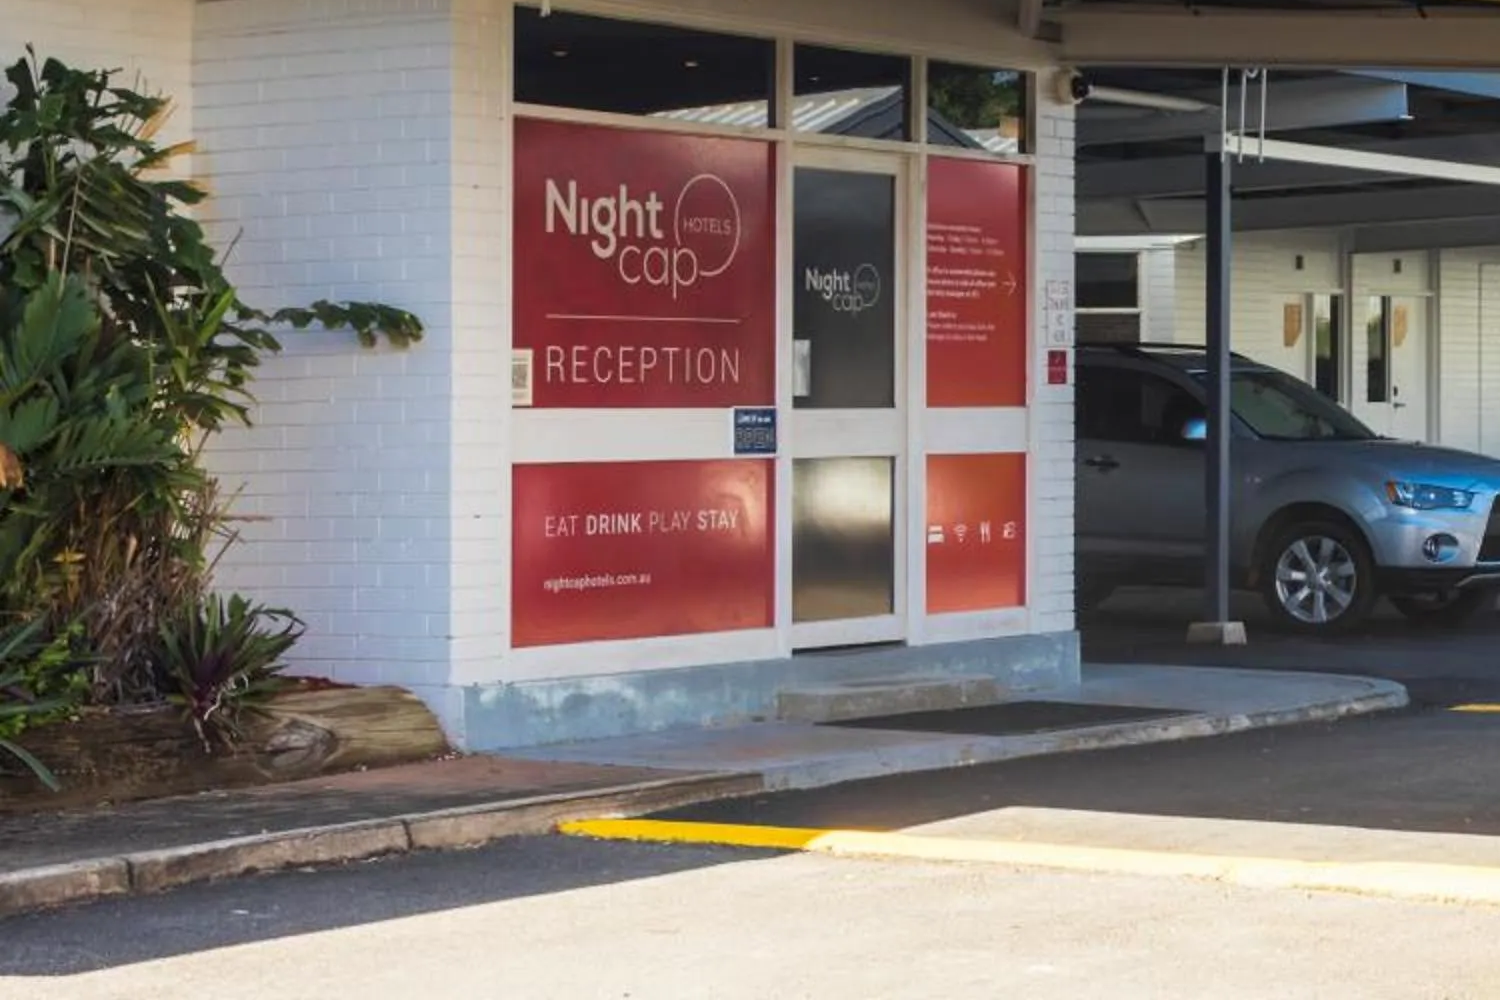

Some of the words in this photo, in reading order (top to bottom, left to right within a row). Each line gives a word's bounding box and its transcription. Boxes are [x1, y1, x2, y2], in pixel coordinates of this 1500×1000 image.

[545, 178, 664, 259] Night
[682, 217, 732, 236] HOTELS
[619, 245, 698, 301] cap
[805, 267, 851, 300] Night
[833, 293, 864, 319] cap
[546, 345, 740, 384] RECEPTION
[545, 515, 578, 538] EAT
[586, 513, 642, 536] DRINK
[649, 511, 691, 533] PLAY
[697, 508, 739, 531] STAY
[543, 572, 652, 594] nightcaphotels.com.au
